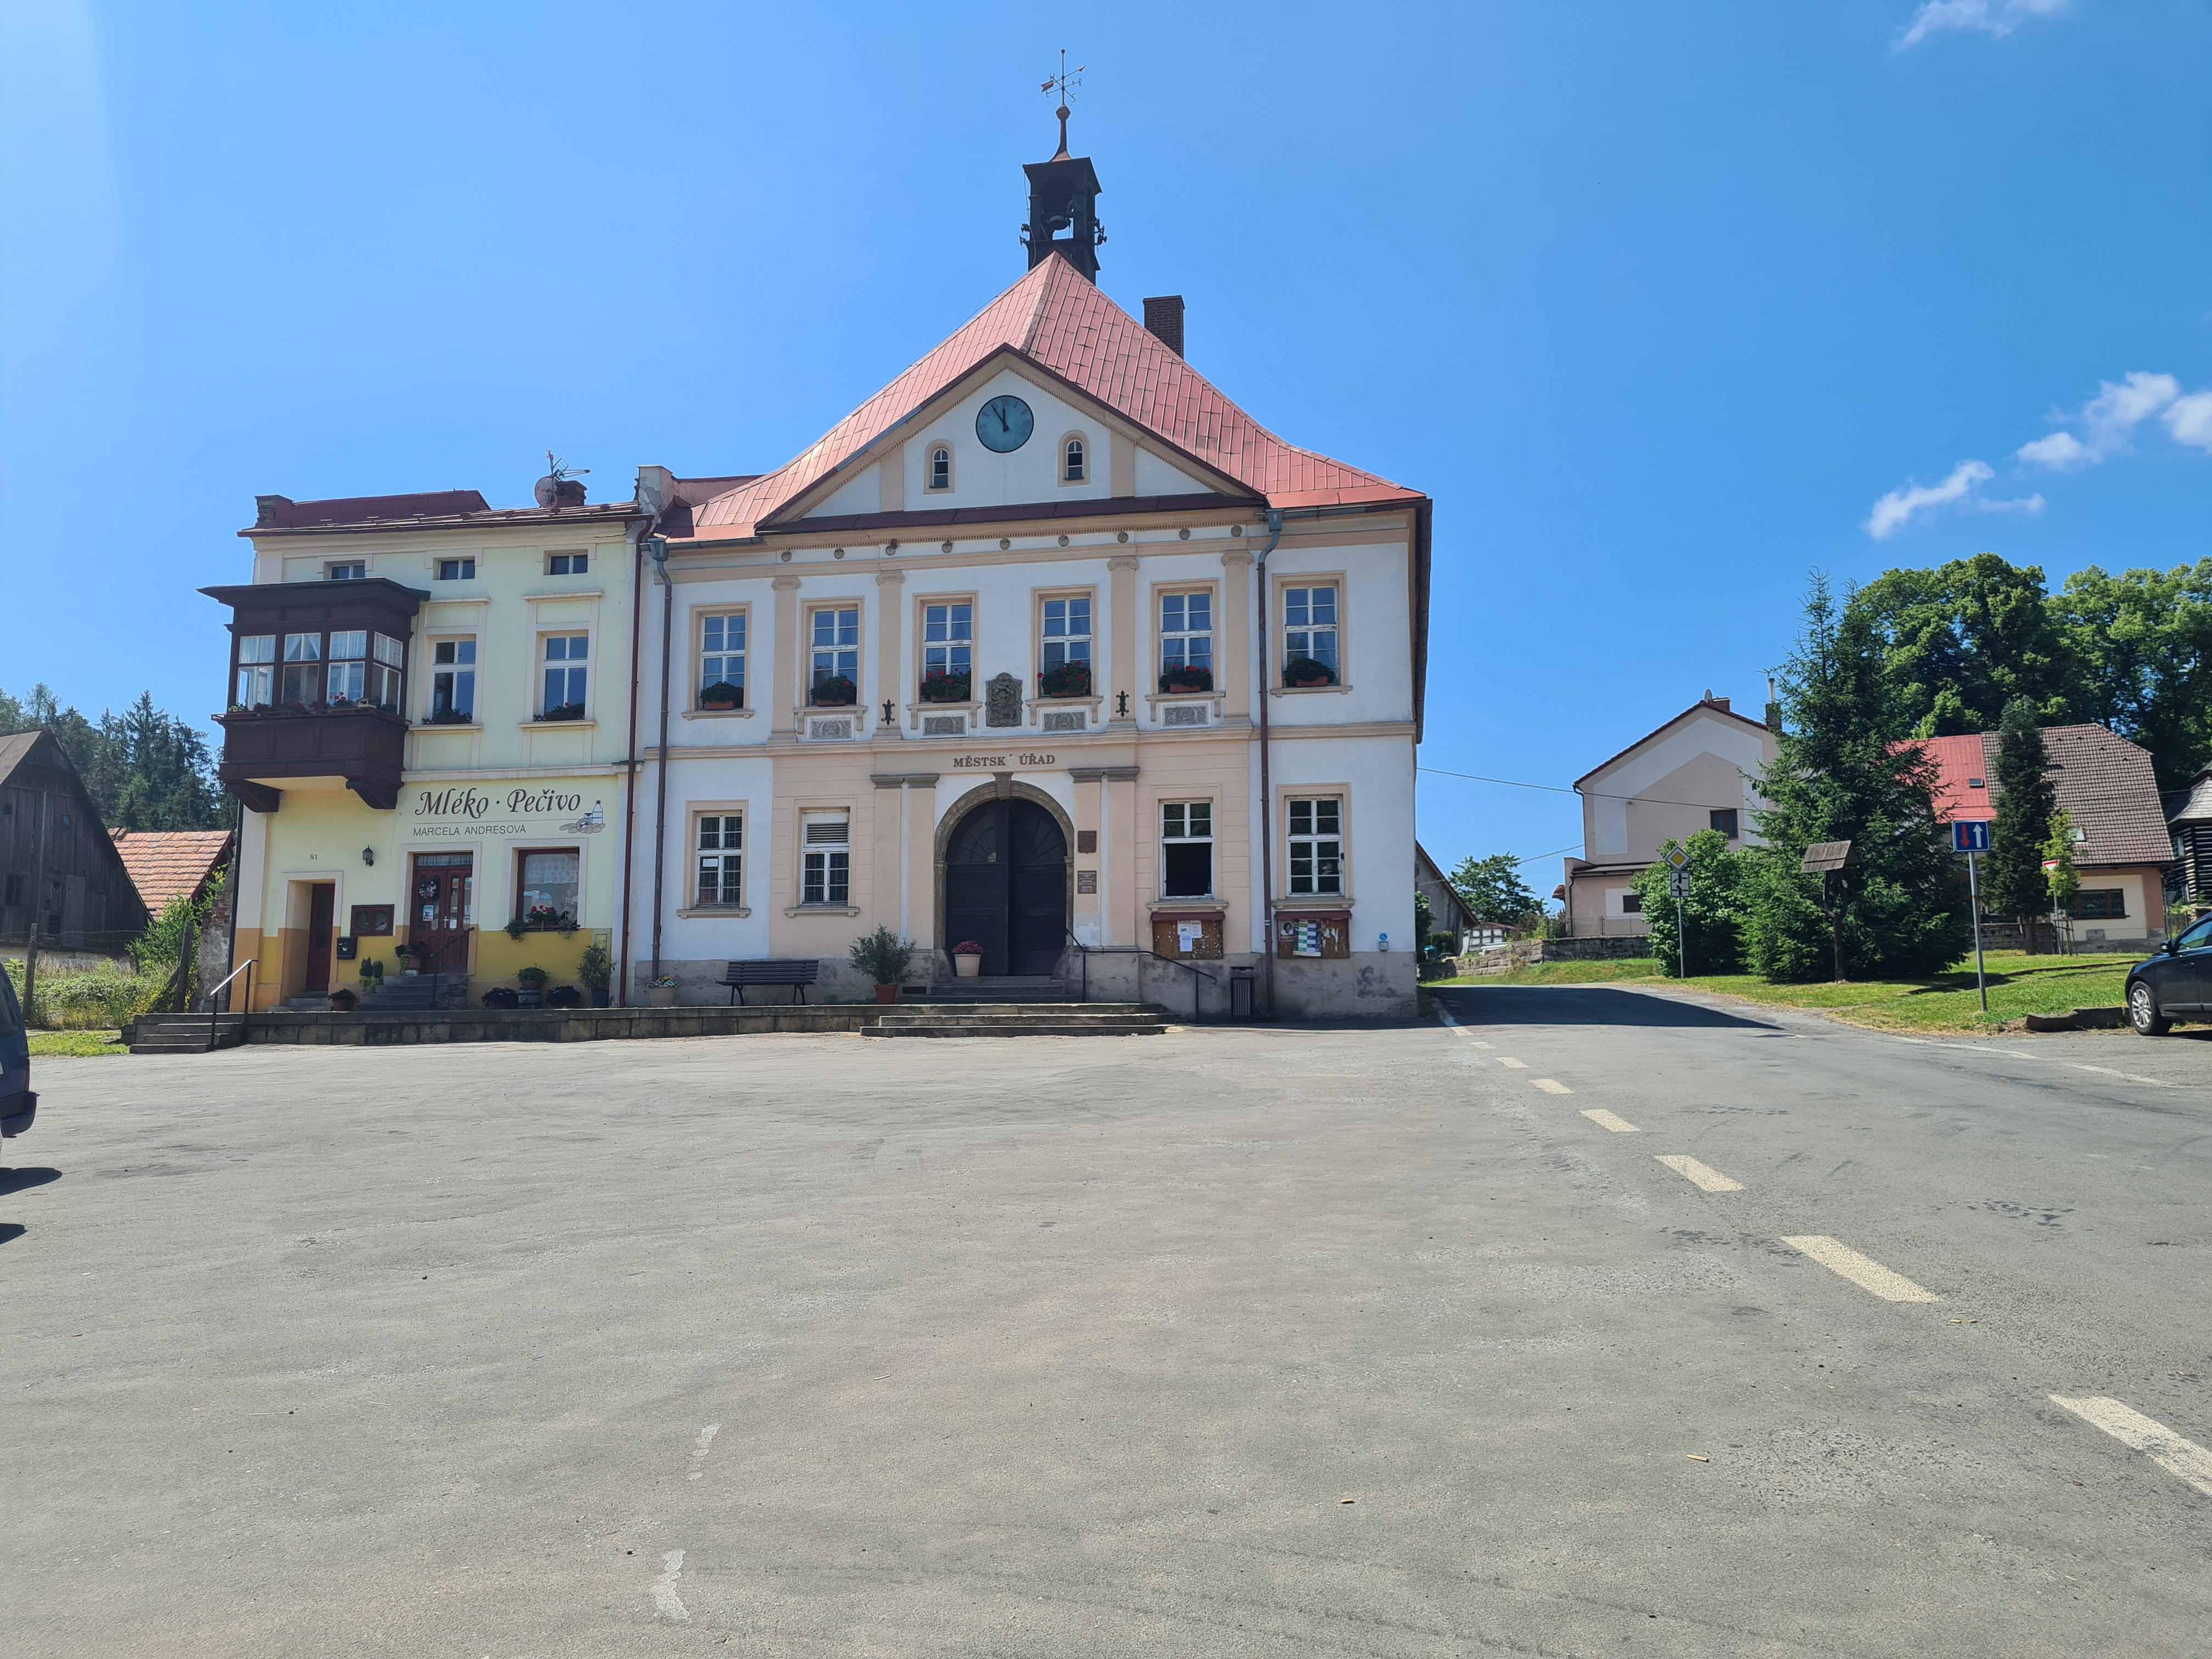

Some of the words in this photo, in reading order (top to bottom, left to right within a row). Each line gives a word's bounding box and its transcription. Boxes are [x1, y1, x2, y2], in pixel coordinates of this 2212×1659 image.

[953, 754, 1012, 767] MĚSTSK
[1019, 753, 1055, 765] ÚŘAD
[414, 787, 489, 819] Mléko
[507, 789, 581, 812] Pečivo
[413, 827, 460, 836] MARCELA
